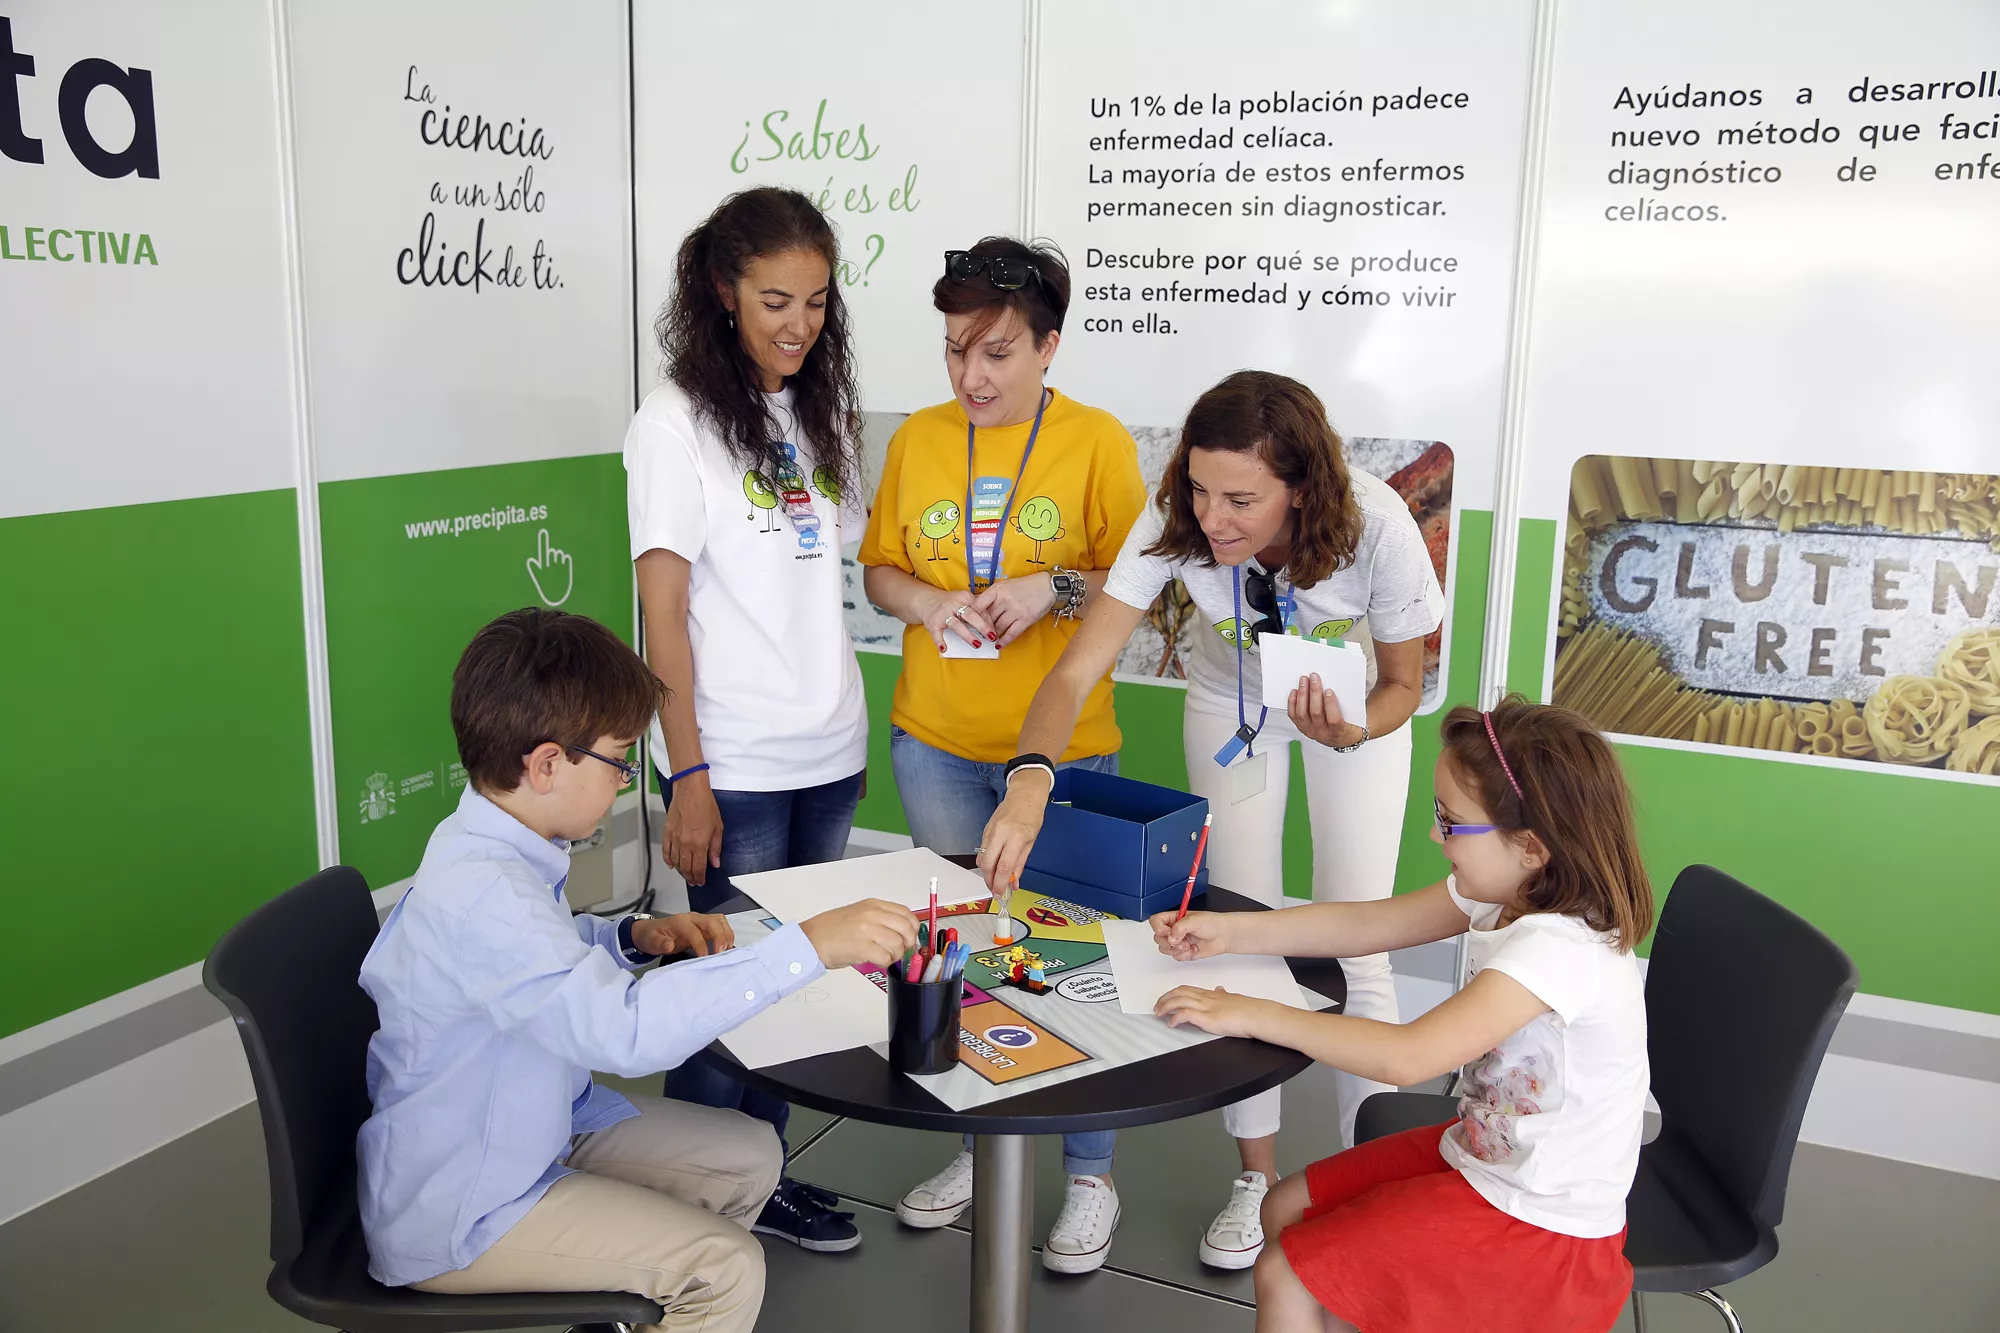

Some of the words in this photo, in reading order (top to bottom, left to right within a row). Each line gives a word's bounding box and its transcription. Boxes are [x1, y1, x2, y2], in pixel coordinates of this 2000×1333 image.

[405, 65, 436, 104] La
[1613, 83, 1763, 117] Ayúdanos
[1796, 88, 1813, 106] a
[1091, 97, 1121, 119] Un
[1130, 95, 1166, 118] 1%
[1174, 93, 1204, 117] de
[1212, 93, 1231, 116] la
[1240, 90, 1363, 121] población
[1372, 86, 1470, 118] padece
[421, 105, 554, 160] ciencia
[731, 98, 880, 173] ¿Sabes
[1089, 125, 1234, 152] enfermedad
[1243, 124, 1334, 149] celíaca.
[1611, 129, 1701, 148] nuevo
[1717, 118, 1841, 146] método
[1859, 123, 1921, 150] que
[430, 182, 448, 204] a
[455, 184, 491, 207] un
[495, 165, 546, 213] sólo
[844, 184, 879, 214] es
[889, 164, 921, 212] el
[1089, 163, 1113, 185] La
[1123, 161, 1216, 191] mayoría
[1226, 159, 1256, 184] de
[1266, 163, 1332, 183] estos
[1341, 157, 1465, 182] enfermos
[1608, 159, 1782, 192] diagnóstico
[1837, 156, 1877, 183] de
[1088, 200, 1233, 223] permanecen
[1242, 196, 1274, 217] sin
[1284, 193, 1447, 224] diagnosticar.
[1604, 196, 1728, 222] celíacos.
[0, 225, 158, 266] LECTIVA
[397, 212, 494, 294] click
[497, 245, 527, 288] de
[532, 239, 564, 290] ti.
[1087, 247, 1195, 270] Descubre
[1205, 254, 1248, 277] por
[1257, 249, 1303, 277] qué
[1313, 255, 1340, 272] se
[1351, 249, 1459, 278] produce
[1085, 282, 1131, 302] esta
[1141, 279, 1288, 305] enfermedad
[1297, 289, 1313, 311] y
[1322, 283, 1391, 307] cómo
[1402, 285, 1457, 308] vivir
[1084, 317, 1123, 334] con
[1132, 312, 1179, 335] ella.
[405, 505, 548, 539] www.precipita.es
[1601, 535, 1998, 618] GLUTEN
[1694, 618, 1891, 677] FREE
